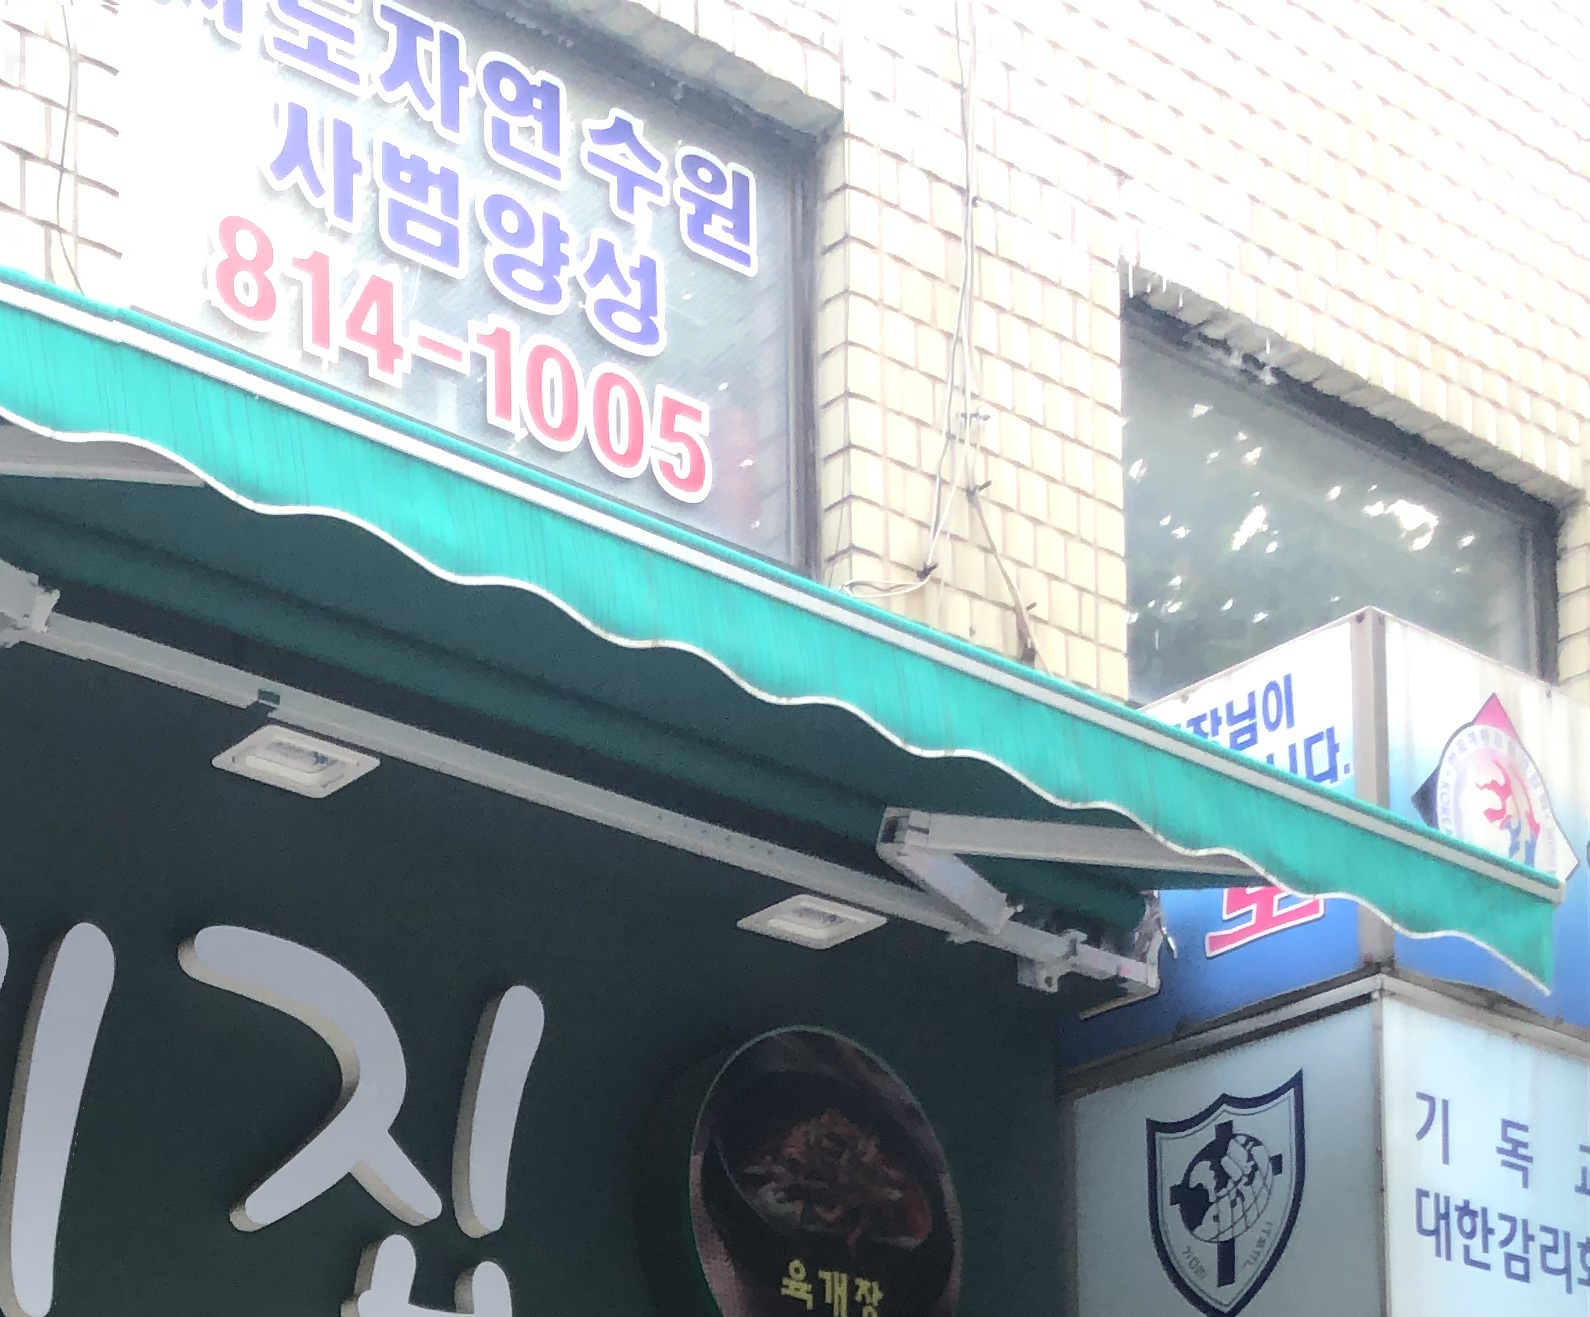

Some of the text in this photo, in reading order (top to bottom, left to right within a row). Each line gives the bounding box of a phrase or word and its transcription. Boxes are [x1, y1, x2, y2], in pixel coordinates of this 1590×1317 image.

[201, 0, 757, 268] 도자연수원
[269, 102, 662, 350] 사범양성
[214, 215, 710, 500] 814-1005
[1173, 672, 1296, 752] 장님이
